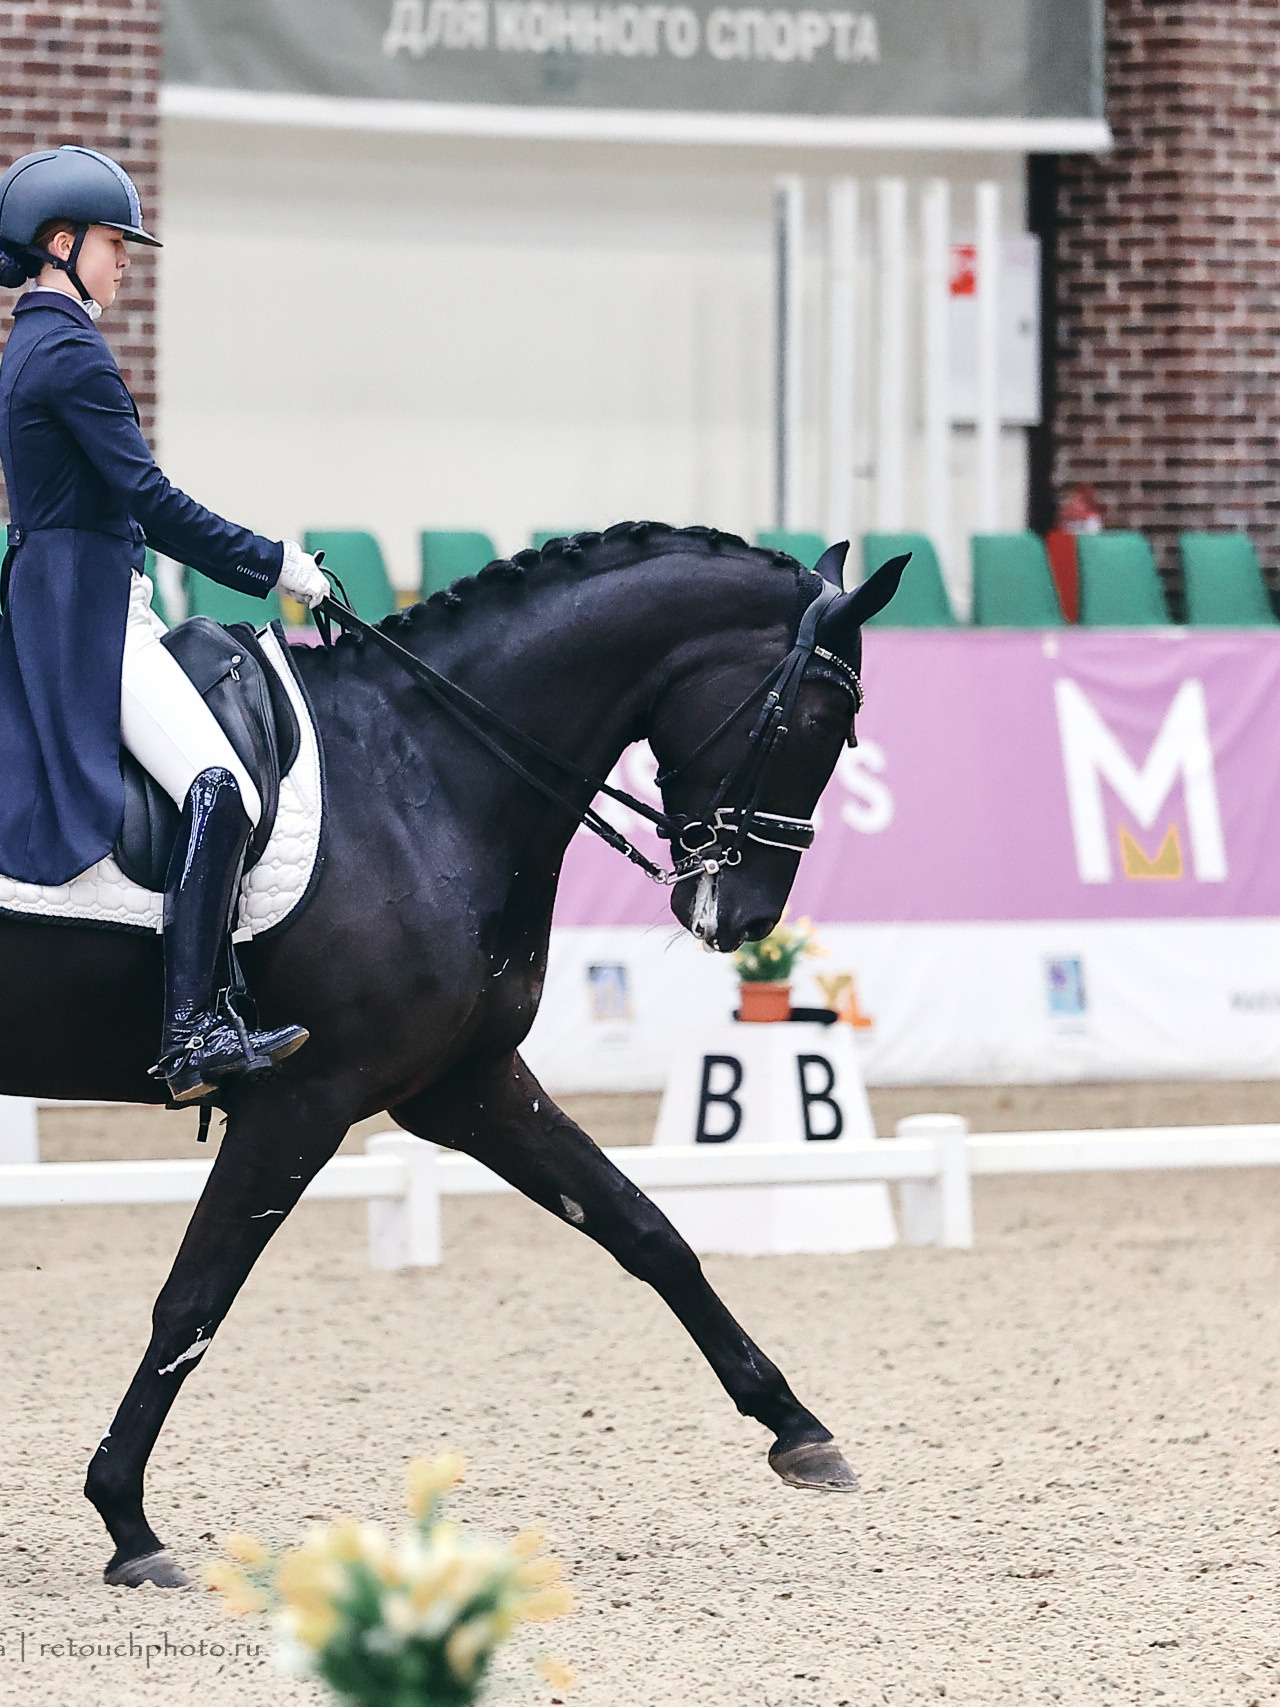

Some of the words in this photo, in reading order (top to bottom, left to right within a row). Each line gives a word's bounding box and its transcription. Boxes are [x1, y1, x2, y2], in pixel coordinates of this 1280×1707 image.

[382, 0, 489, 58] ДЛЯ
[493, 1, 700, 58] КОННОГО
[706, 7, 881, 62] СПОРТА
[696, 1054, 743, 1143] B
[796, 1054, 843, 1141] B
